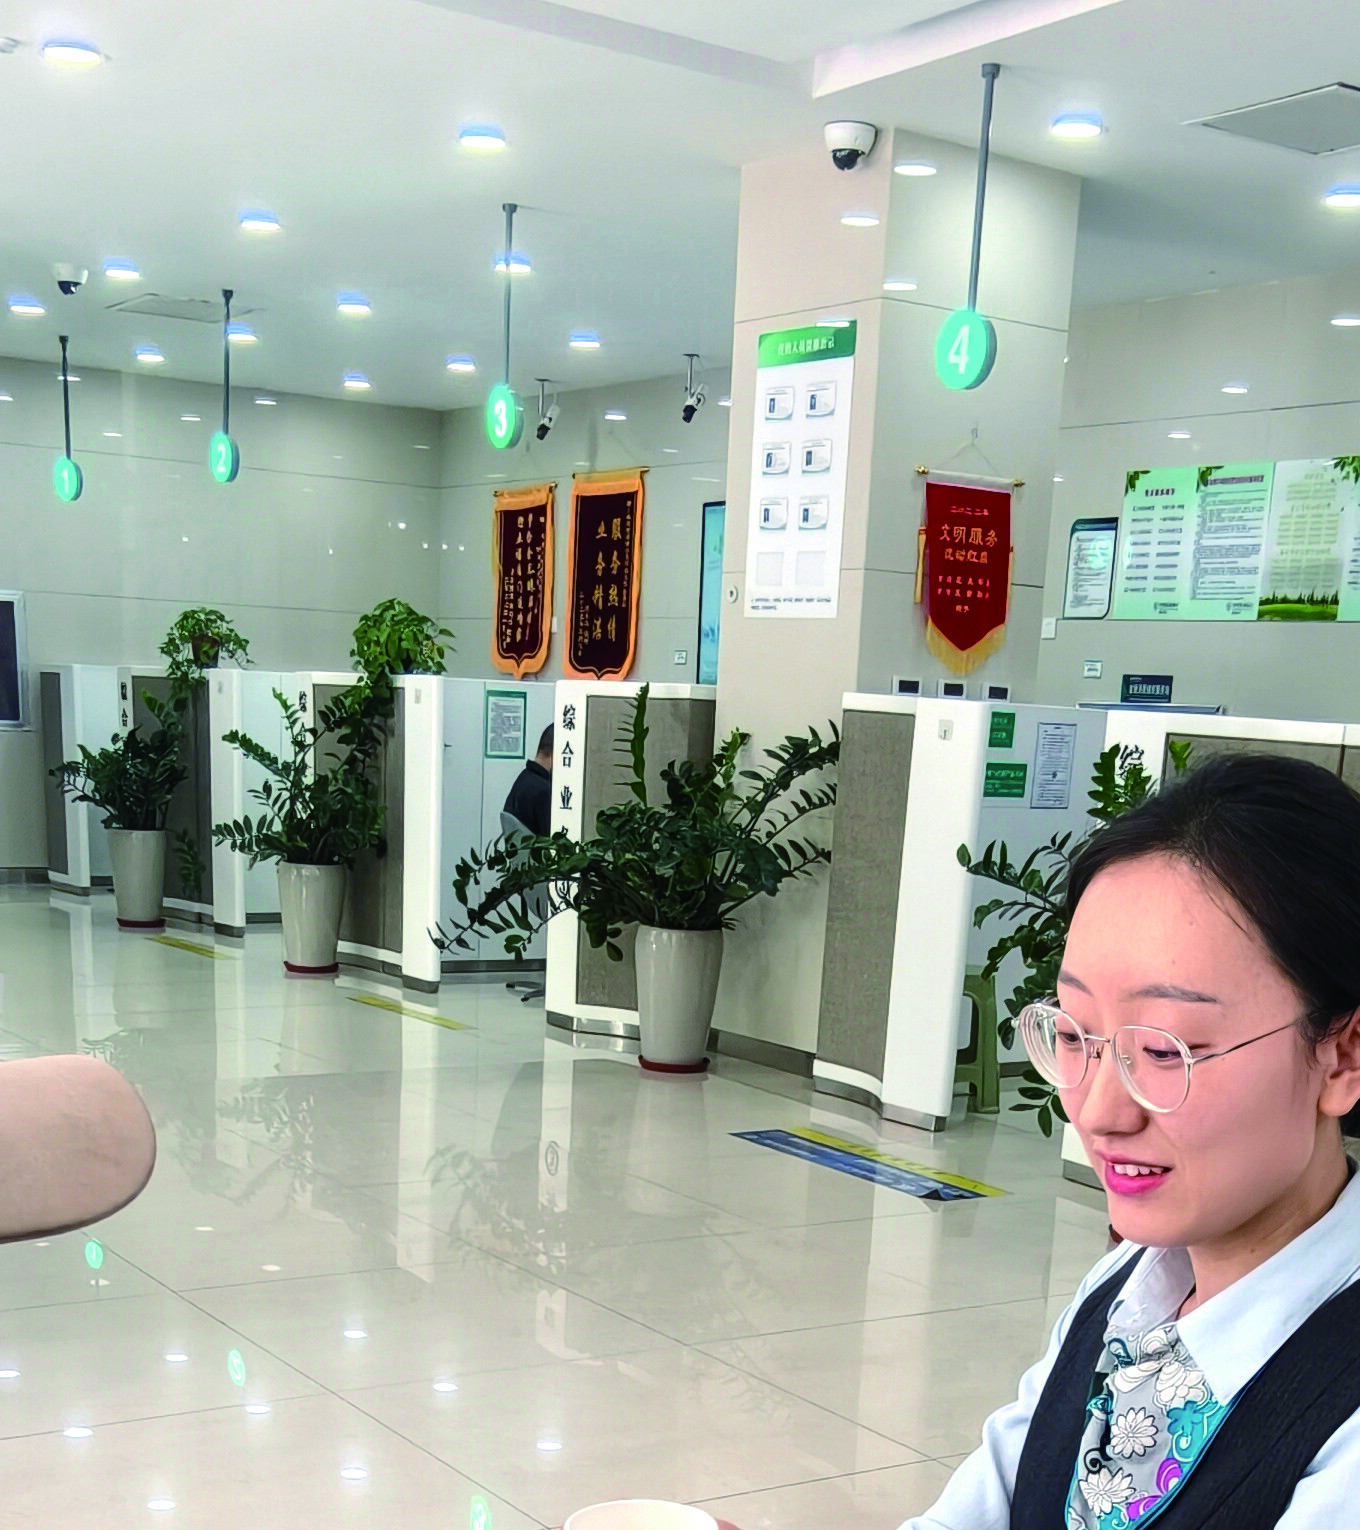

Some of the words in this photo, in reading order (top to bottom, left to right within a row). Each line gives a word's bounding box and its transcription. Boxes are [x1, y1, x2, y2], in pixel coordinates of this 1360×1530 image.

[947, 325, 970, 375] 4
[494, 400, 507, 439] 3
[217, 444, 226, 473] 2
[61, 469, 69, 494] 1
[939, 523, 998, 547] 文明服务
